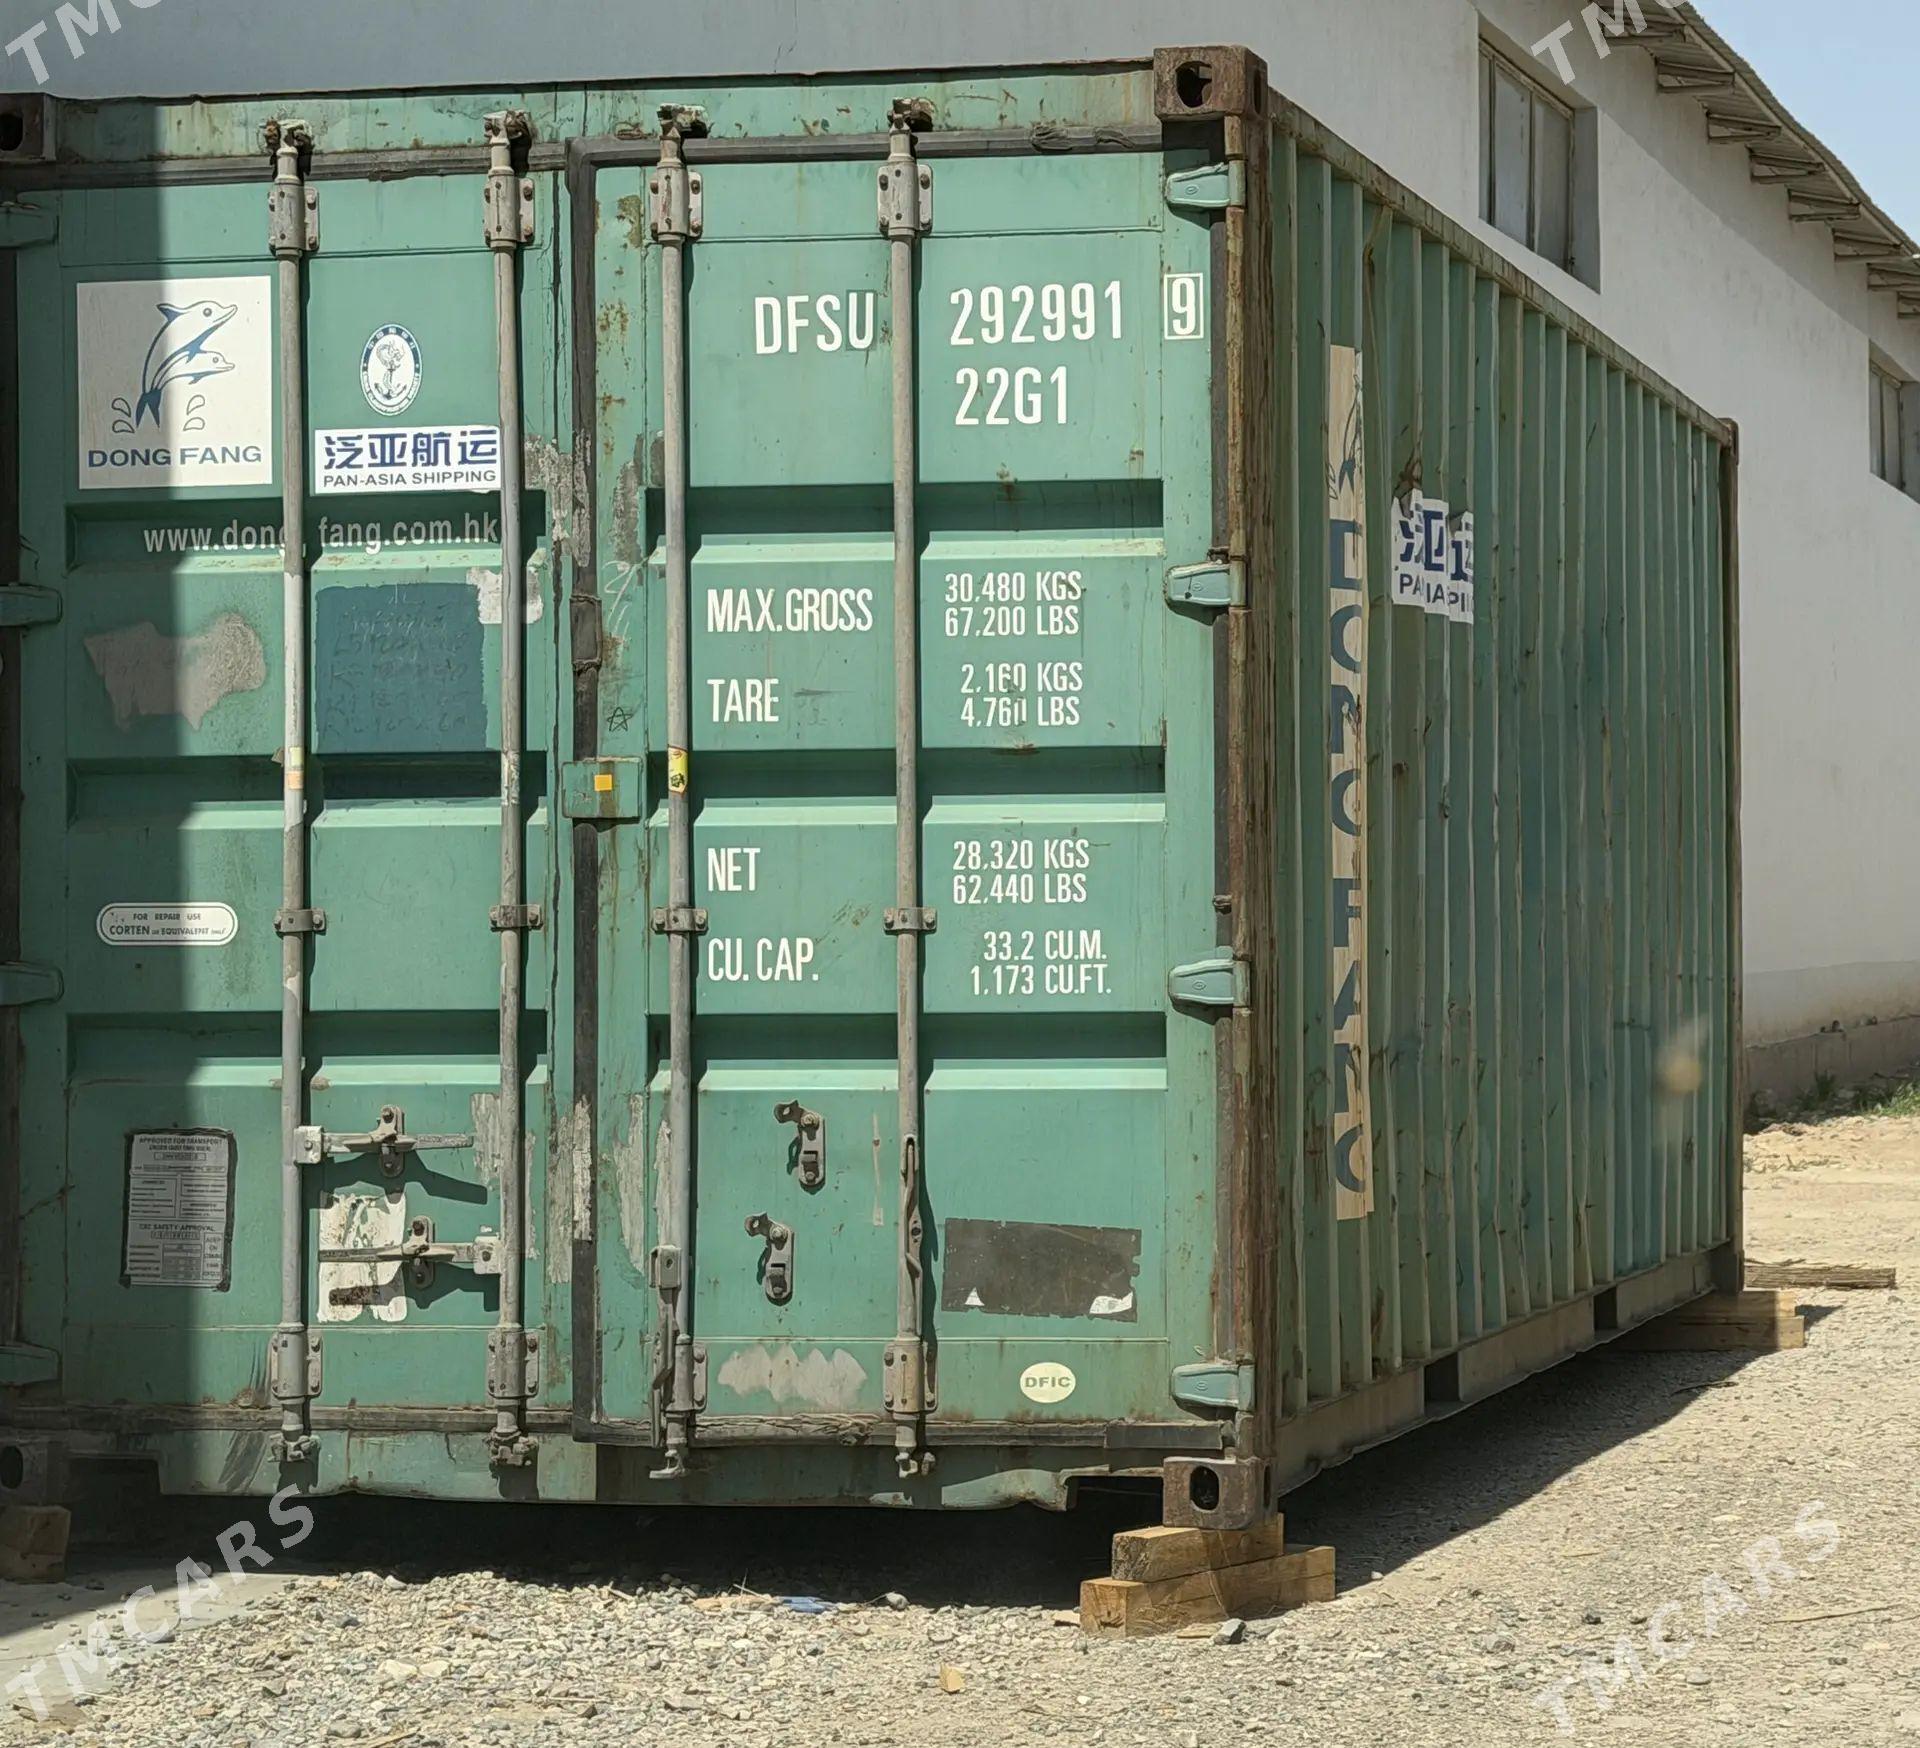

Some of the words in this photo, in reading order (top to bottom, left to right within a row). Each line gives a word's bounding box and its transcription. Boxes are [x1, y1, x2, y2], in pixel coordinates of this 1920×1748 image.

[755, 292, 874, 355] DFSU
[950, 280, 1122, 346] 292991
[1171, 276, 1197, 336] 9
[955, 366, 1067, 426] 22G1
[89, 449, 171, 468] DONG
[180, 446, 262, 465] FANG
[324, 429, 497, 470] 泛亚航运
[324, 473, 406, 487] PAN-ASIA
[412, 470, 496, 485] SHIPPING
[1036, 571, 1082, 601] KGS
[707, 588, 873, 633] MAX.GROSS
[1036, 604, 1079, 635] LBS
[1037, 661, 1083, 692] KGS
[707, 678, 779, 722] TARE
[1037, 695, 1080, 726] LBS
[1044, 838, 1090, 869] KGS
[707, 847, 761, 892] NET
[1044, 872, 1087, 903] LBS
[110, 925, 150, 936] CORTEN
[161, 927, 209, 936] EQUIVALENT
[133, 912, 148, 921] FOR
[154, 912, 181, 921] REPAIR
[186, 913, 202, 921] USE
[983, 930, 1034, 961] 33.2
[1024, 1376, 1071, 1388] DFIC
